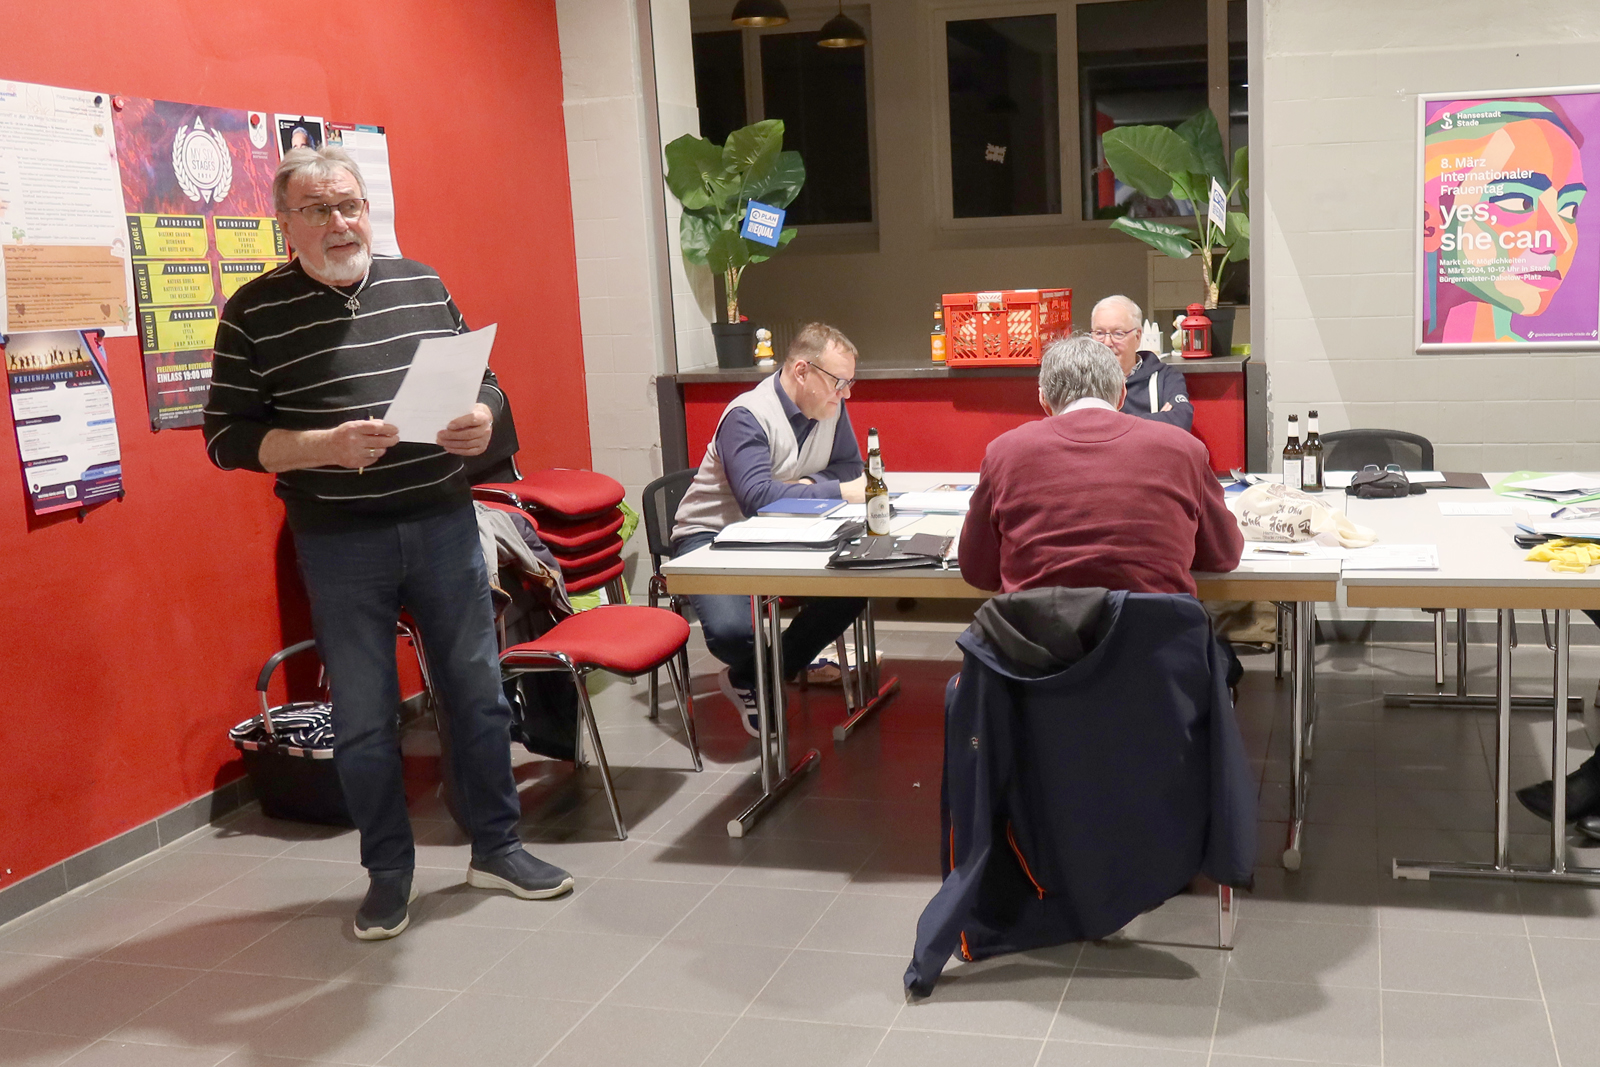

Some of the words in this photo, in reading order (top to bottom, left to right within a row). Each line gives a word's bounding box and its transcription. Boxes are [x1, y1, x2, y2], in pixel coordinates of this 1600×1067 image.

[1457, 111, 1502, 119] Hansestadt
[191, 148, 200, 159] MY
[203, 148, 214, 160] SIX
[192, 160, 215, 171] STAGES
[1441, 158, 1452, 169] 8.
[1455, 157, 1486, 168] März
[1441, 169, 1534, 182] Internationaler
[1441, 183, 1504, 196] Frauentag
[761, 214, 777, 222] PLAN
[1440, 202, 1498, 229] yes,
[132, 227, 142, 250] STAGE
[1440, 230, 1492, 251] she
[1499, 229, 1552, 250] can
[1440, 274, 1542, 284] Bürgermeister-Dabelow-Platz
[140, 276, 148, 299] STAGE
[14, 371, 73, 383] FERIENFAHRTEN
[157, 372, 182, 383] EINLASS
